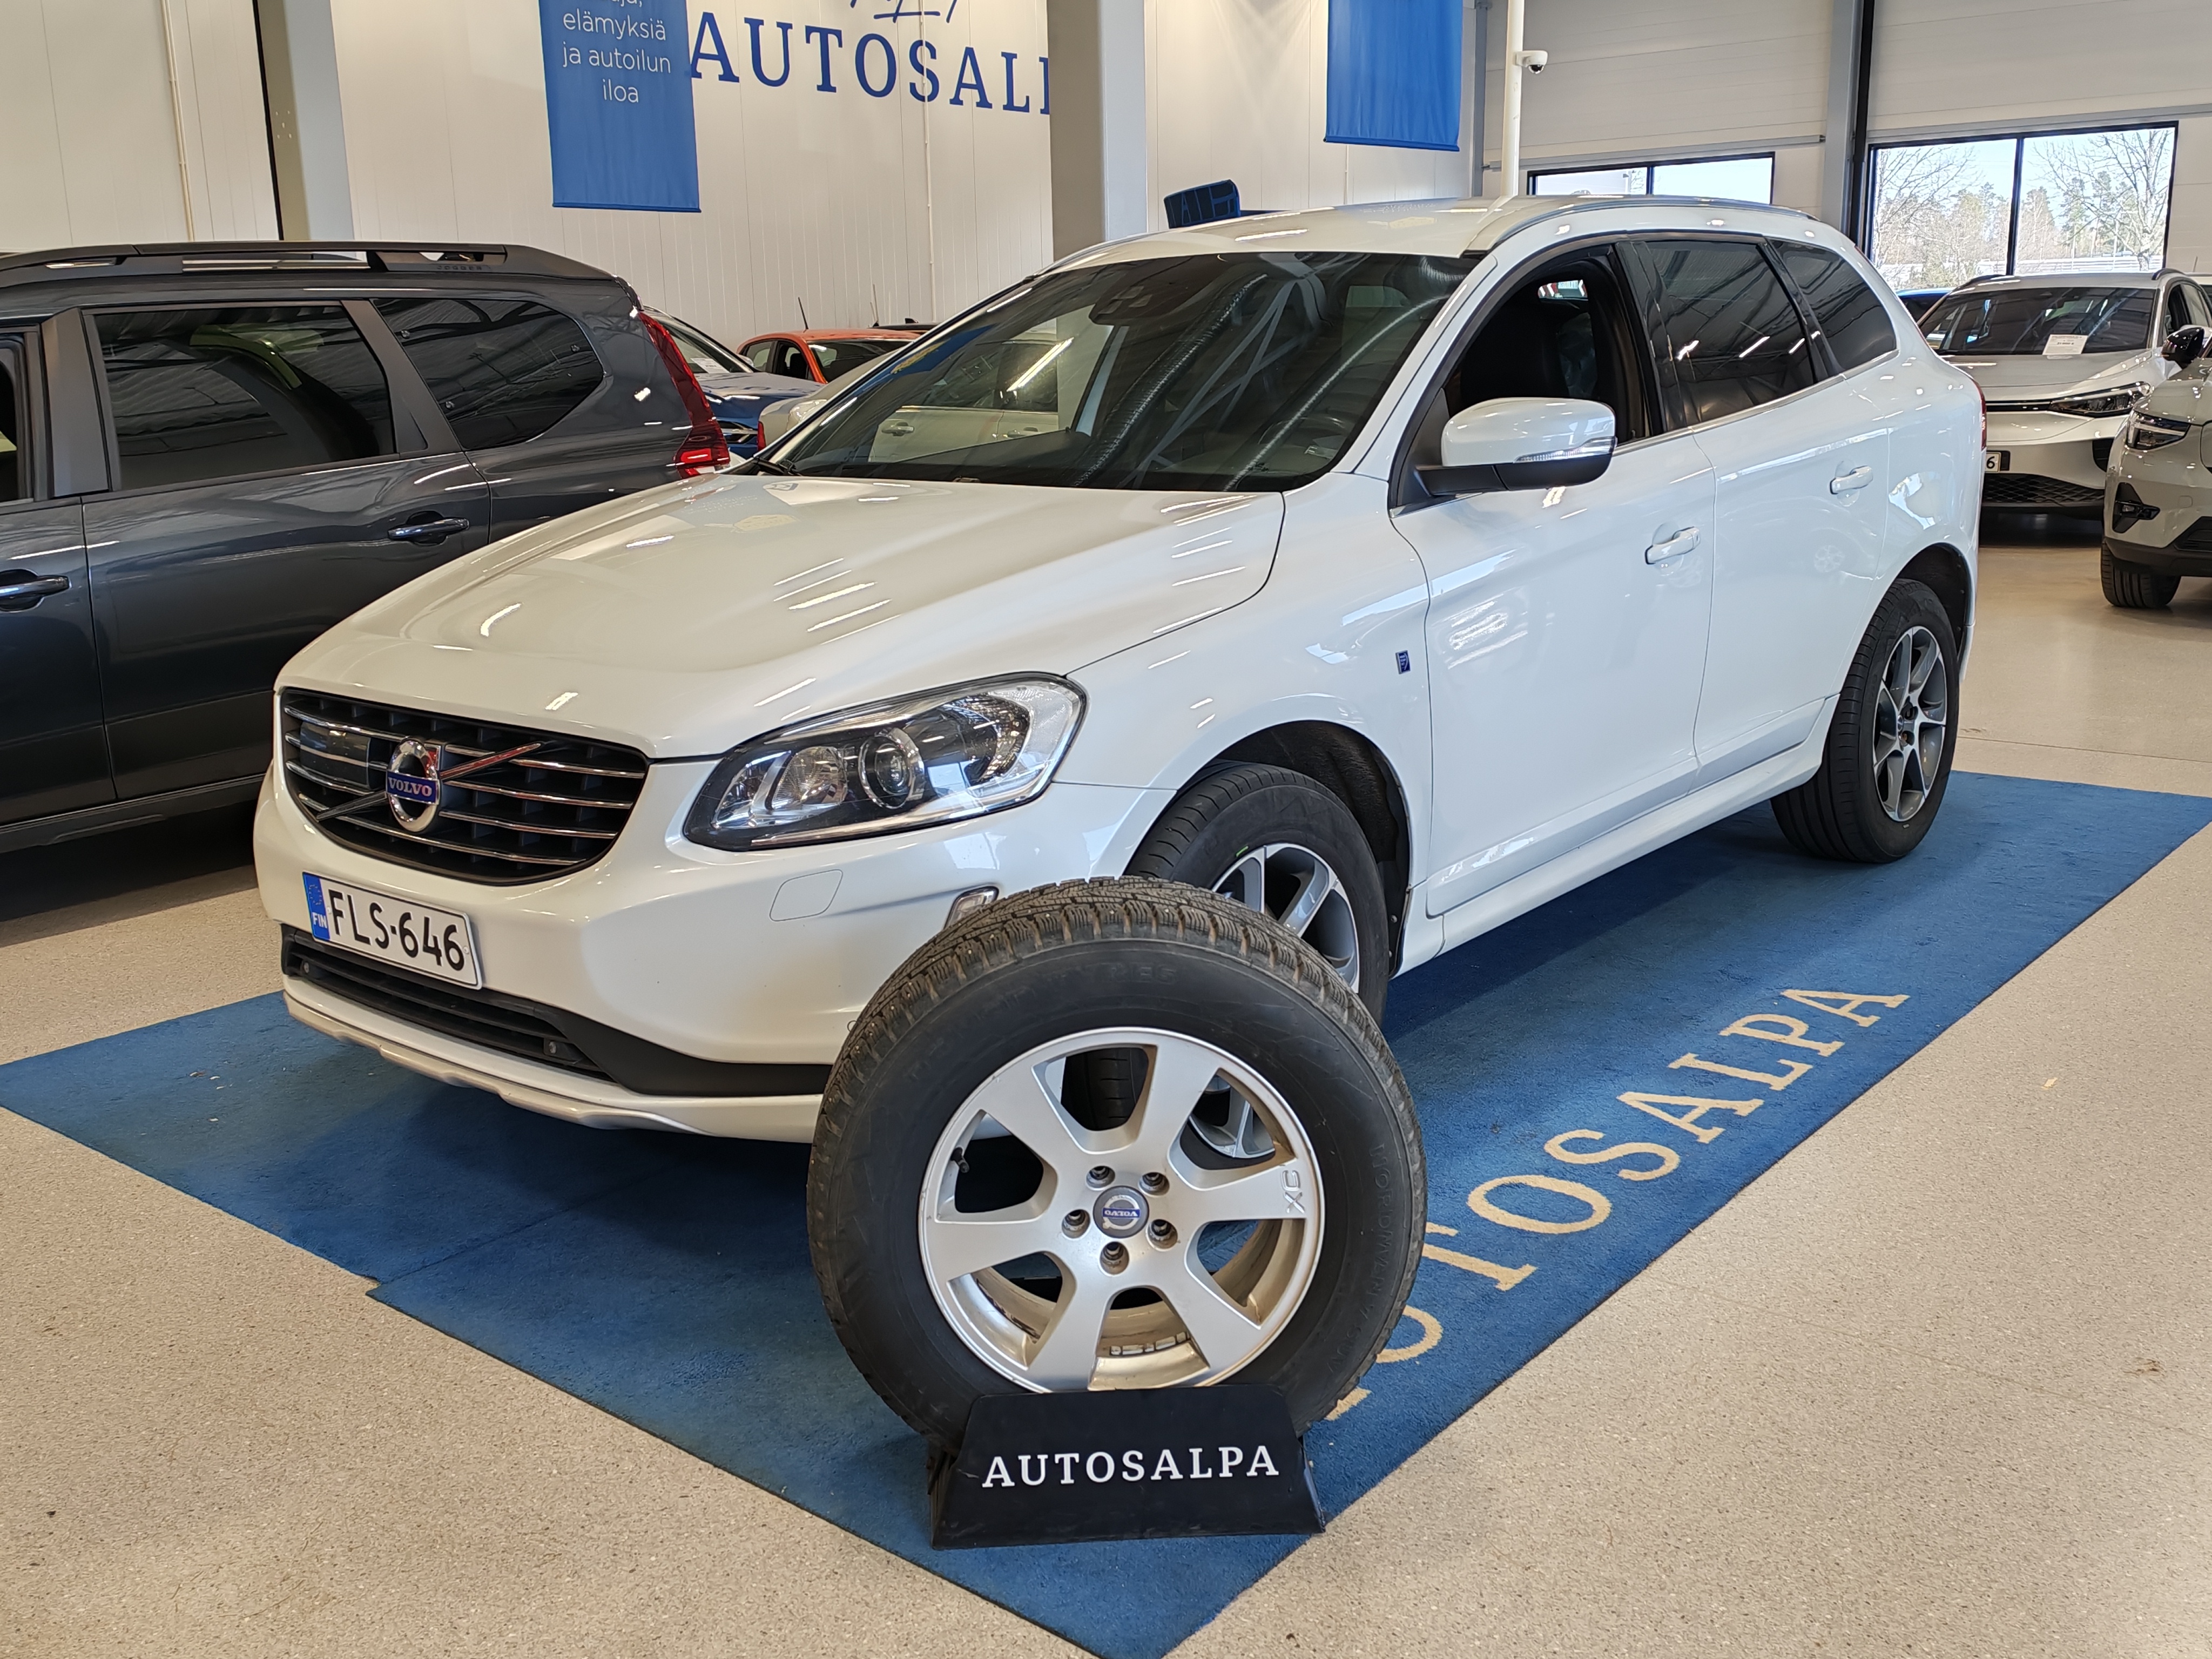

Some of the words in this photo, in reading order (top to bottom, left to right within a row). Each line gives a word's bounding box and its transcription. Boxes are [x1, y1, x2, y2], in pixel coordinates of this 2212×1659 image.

[563, 8, 666, 41] elämyksiä
[562, 41, 582, 68] ja
[588, 47, 671, 74] autoilun
[602, 78, 639, 103] iloa
[388, 777, 433, 797] VOLVO
[312, 912, 328, 929] FIN
[328, 888, 465, 971] FLS-646
[1281, 1169, 1305, 1213] XC
[1325, 989, 1911, 1421] TOSALPA
[982, 1445, 1279, 1488] AUTOSALPA
